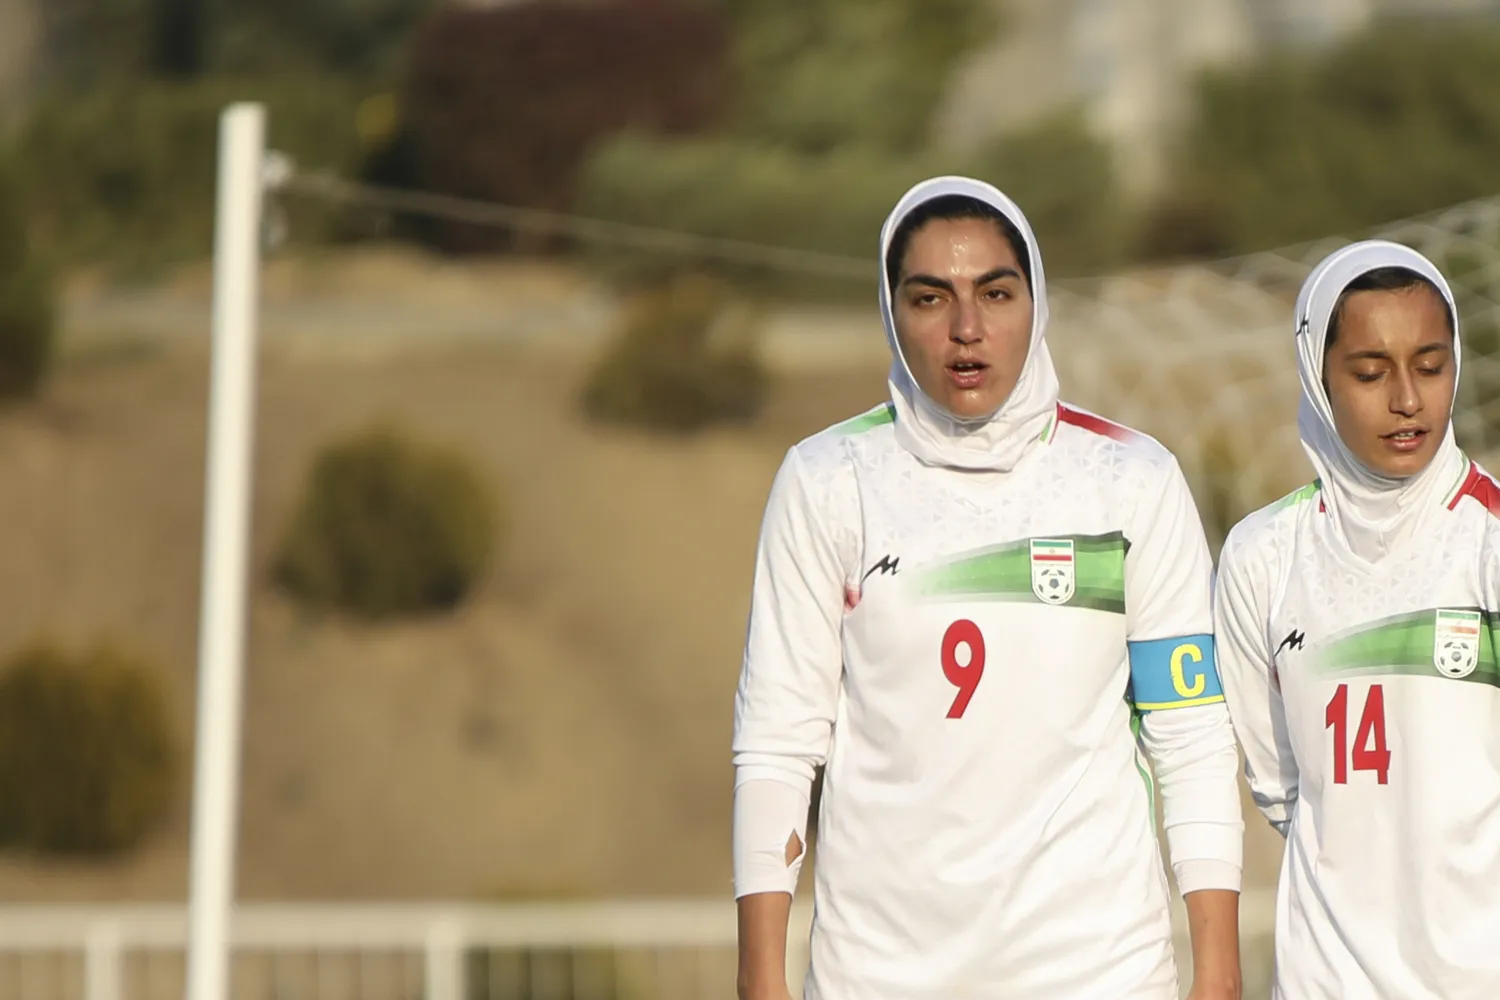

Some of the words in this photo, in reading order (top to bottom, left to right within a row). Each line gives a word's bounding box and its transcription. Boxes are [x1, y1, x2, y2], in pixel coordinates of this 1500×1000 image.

[941, 619, 985, 719] 9
[1170, 643, 1206, 698] C
[1326, 684, 1391, 784] 14
